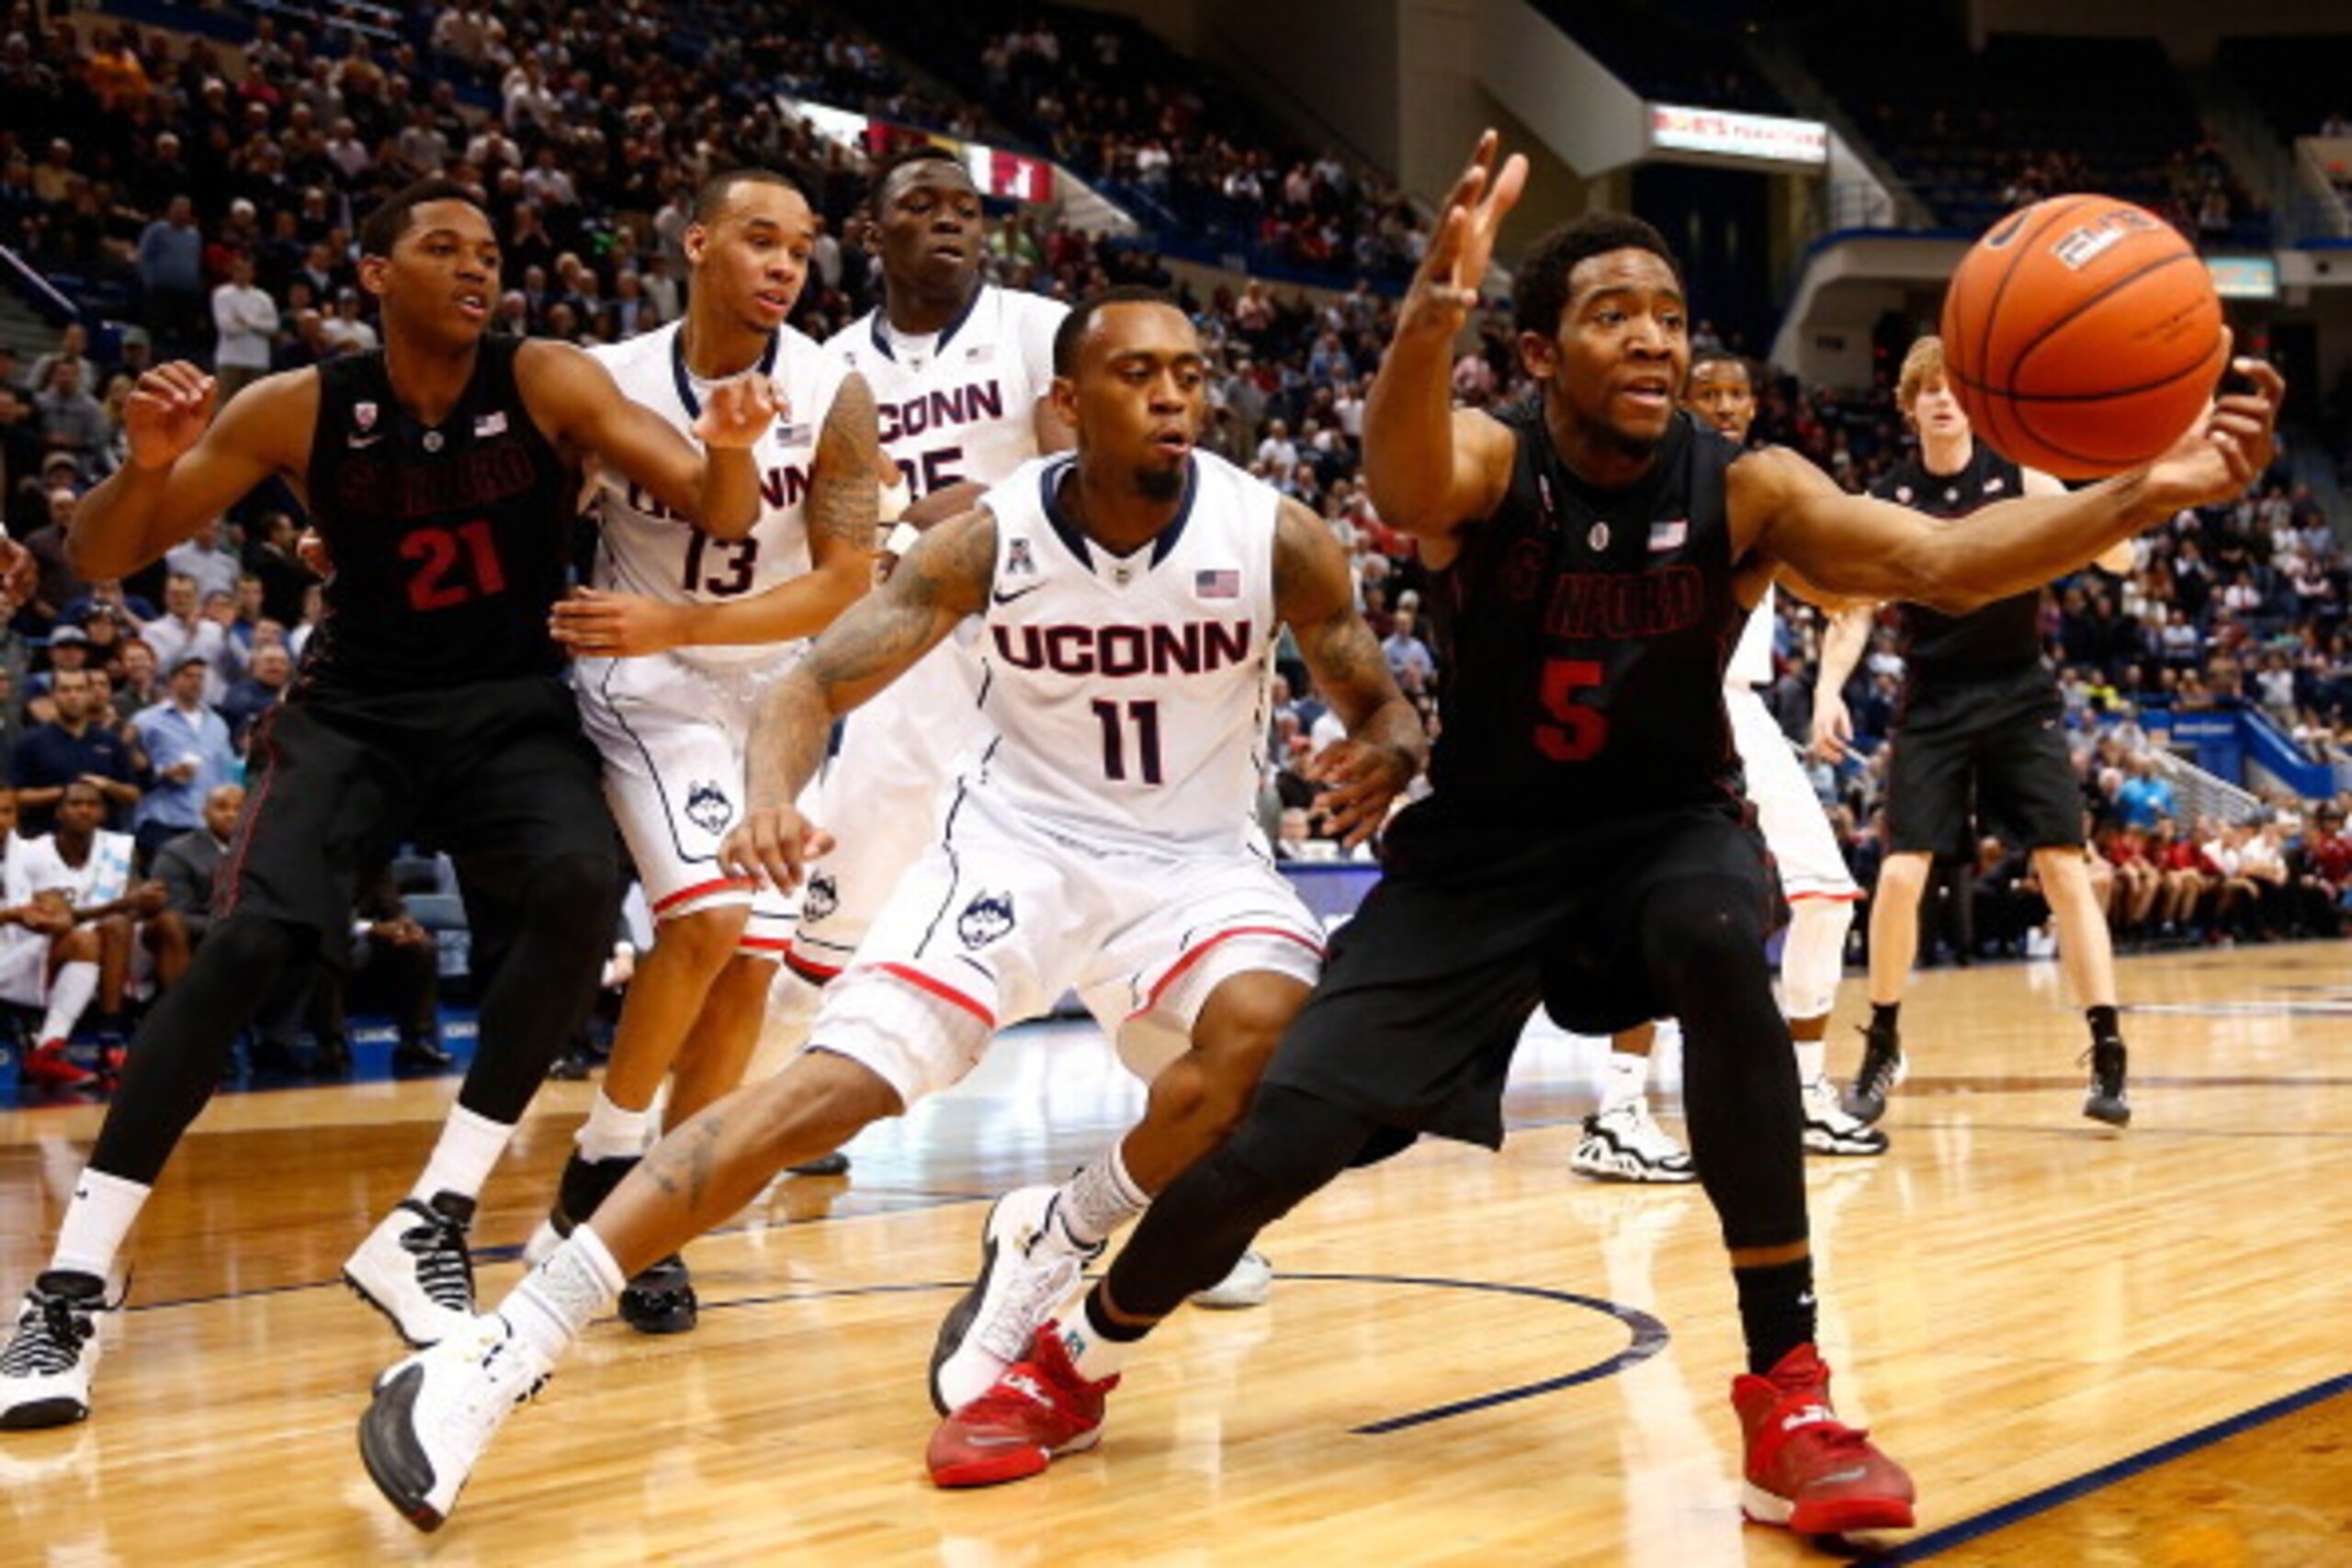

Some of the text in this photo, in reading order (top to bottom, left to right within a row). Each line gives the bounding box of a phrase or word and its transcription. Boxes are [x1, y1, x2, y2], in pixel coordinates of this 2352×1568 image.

[877, 378, 1002, 444] CONN
[398, 518, 507, 613] 21
[684, 527, 759, 596] 13
[990, 620, 1252, 679] UCONN
[1090, 697, 1163, 785] 11
[1533, 657, 1610, 761] 5
